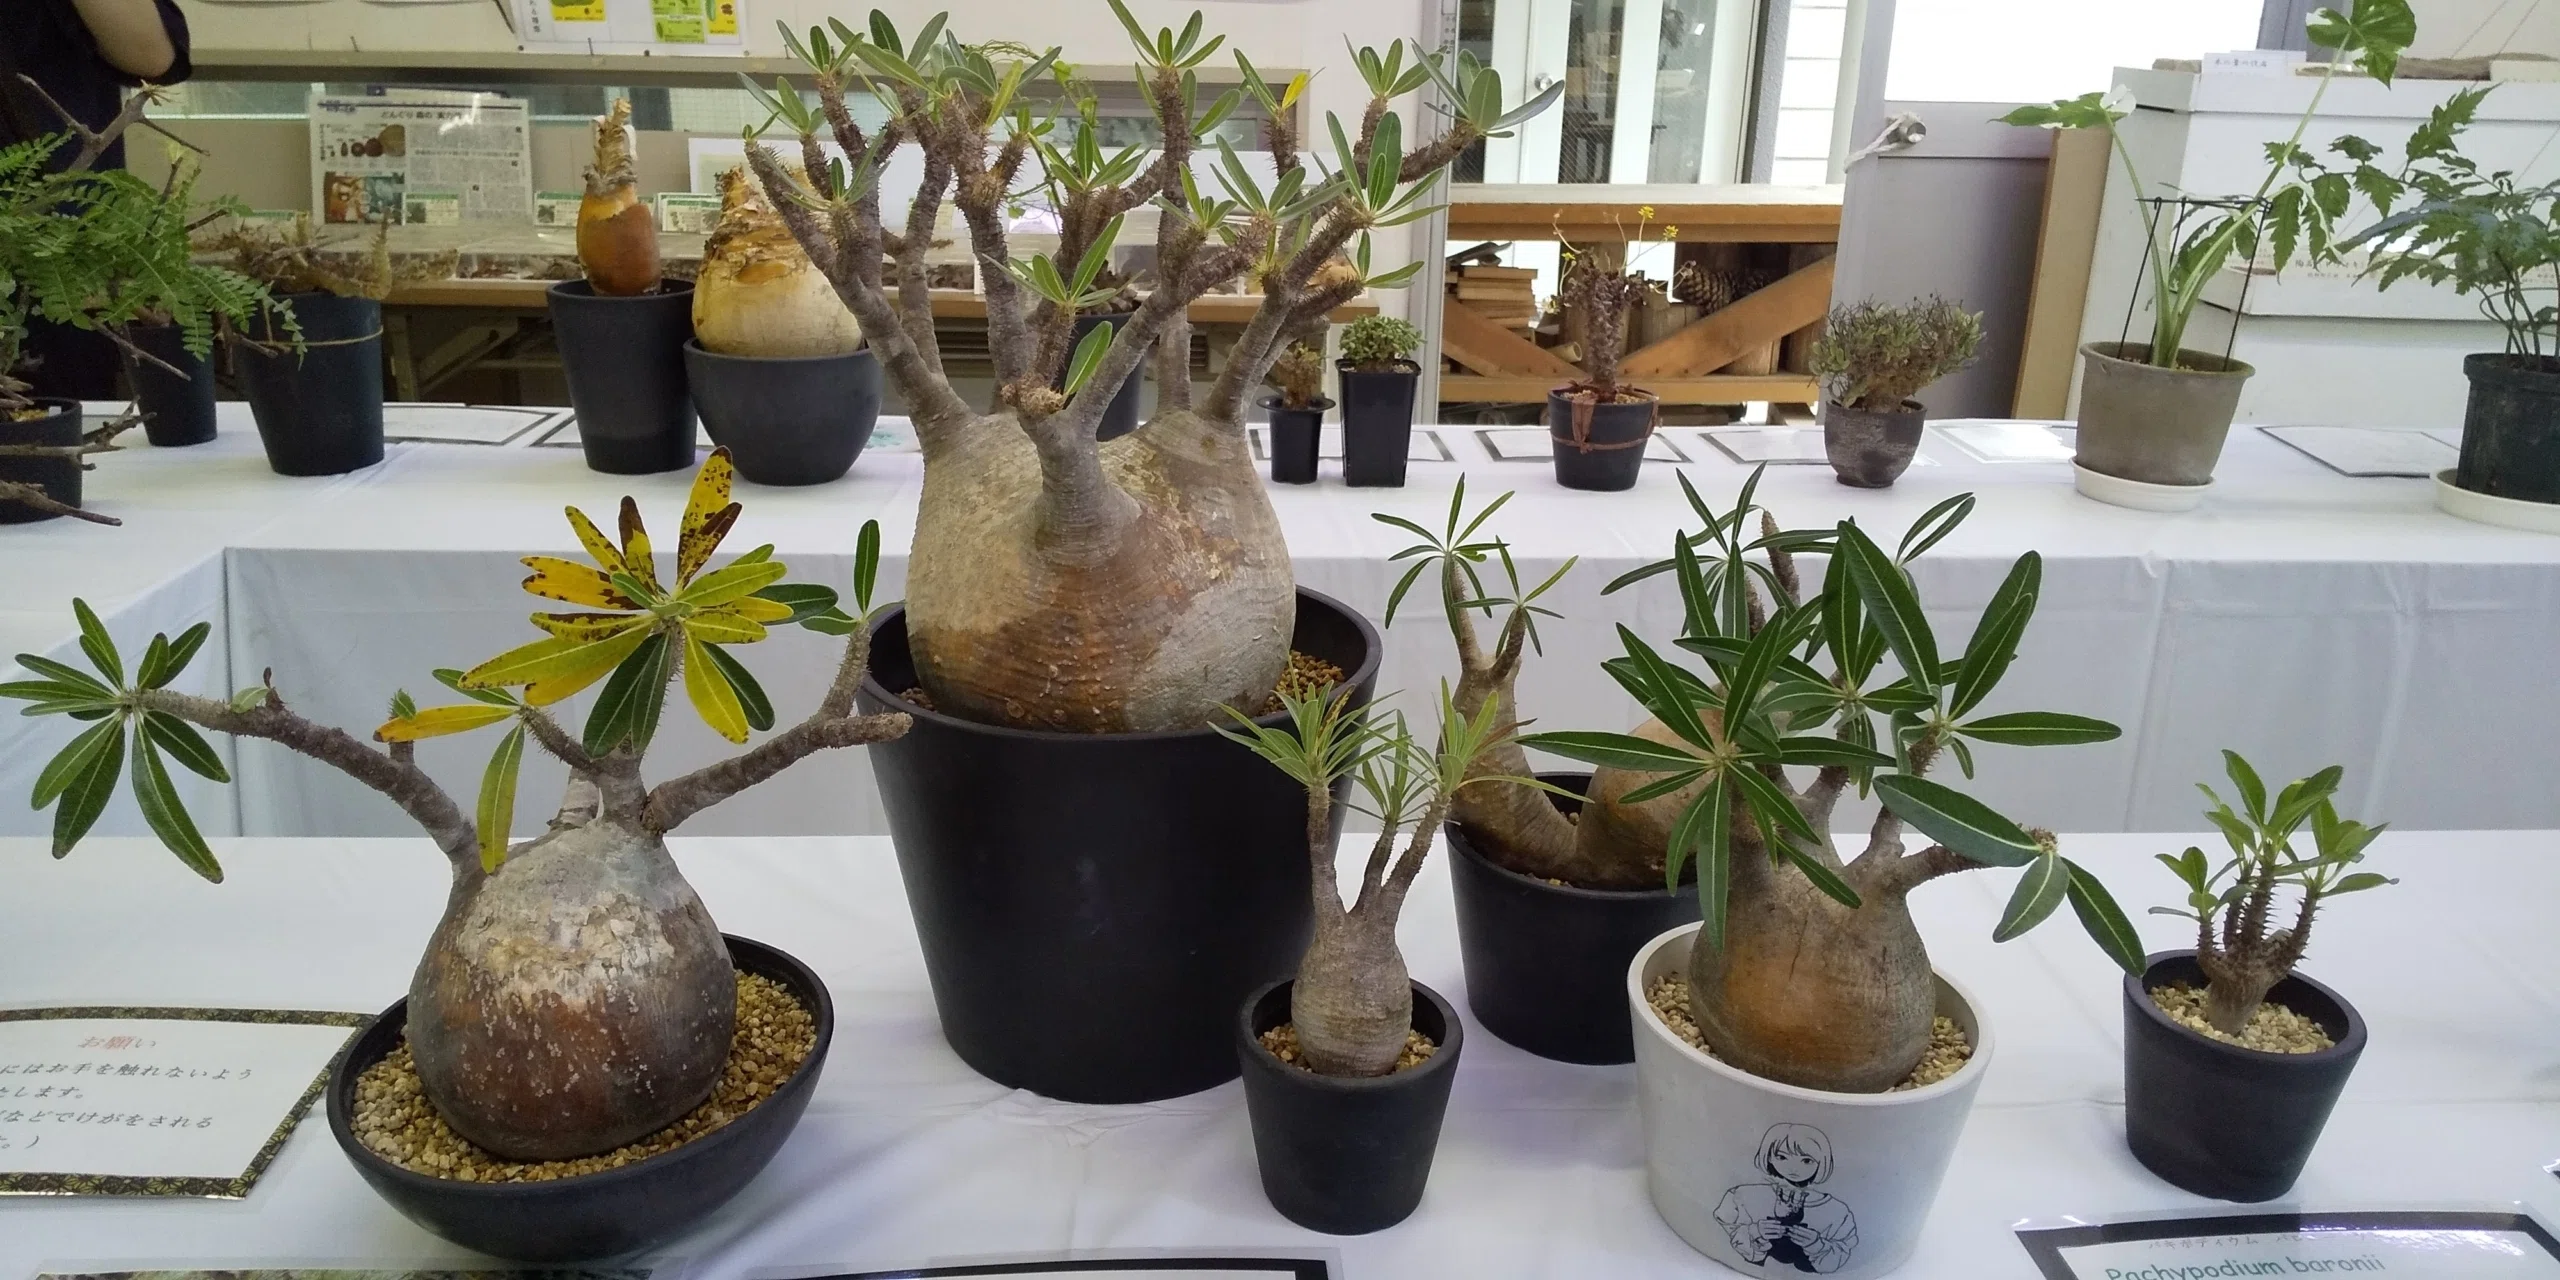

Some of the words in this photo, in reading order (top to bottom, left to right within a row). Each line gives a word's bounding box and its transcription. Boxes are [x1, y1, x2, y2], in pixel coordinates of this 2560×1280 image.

[78, 1035, 157, 1050] お願い
[0, 1062, 252, 1081] にはお手を触れないよう
[0, 1109, 213, 1129] などでけがをされる
[2105, 1258, 2286, 1280] Pachypodium
[2285, 1253, 2387, 1274] baronii
